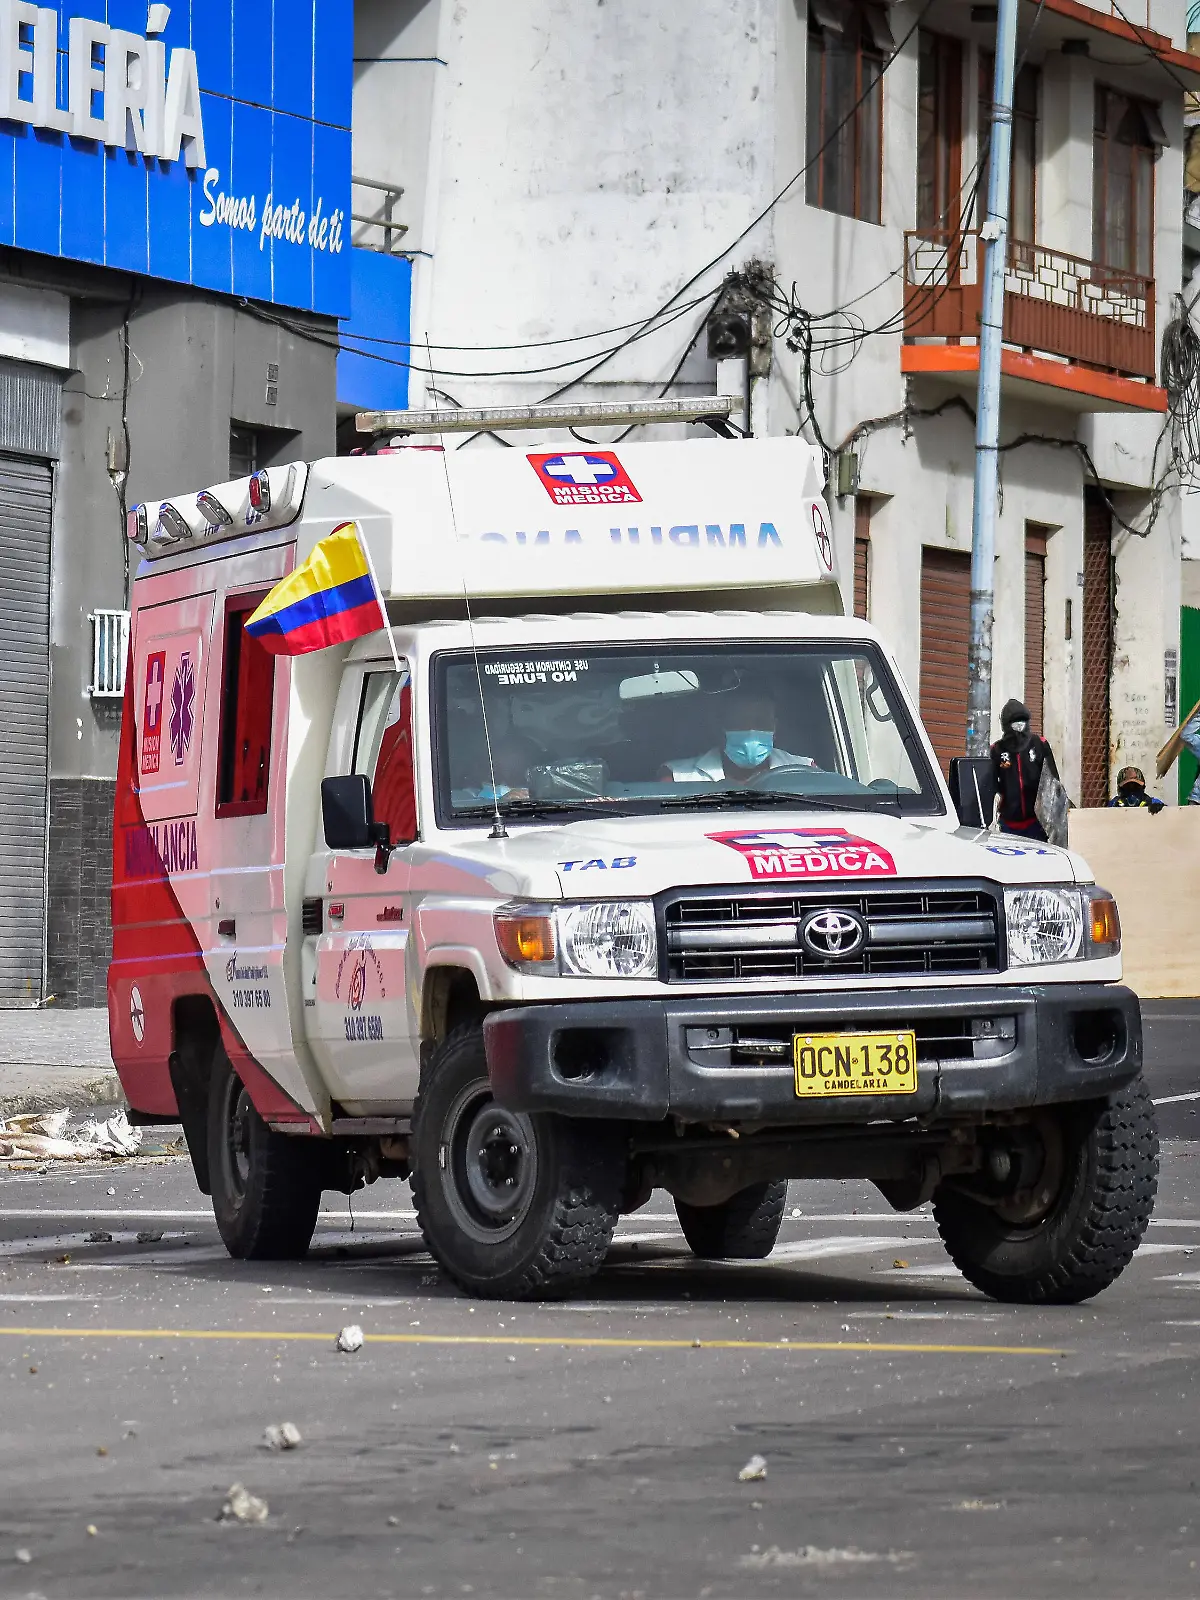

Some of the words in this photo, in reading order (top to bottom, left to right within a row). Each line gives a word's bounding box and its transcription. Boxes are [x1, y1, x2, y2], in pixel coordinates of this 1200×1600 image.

[0, 0, 206, 169] ELERÍA
[200, 168, 256, 231] Somos
[260, 194, 305, 251] parte
[309, 197, 327, 250] de
[329, 209, 344, 253] ti
[552, 486, 630, 495] MISION
[555, 493, 638, 503] MEDICA
[557, 856, 637, 871] TAB
[232, 990, 243, 1007] 310
[824, 1079, 888, 1090] CANDELARIA
